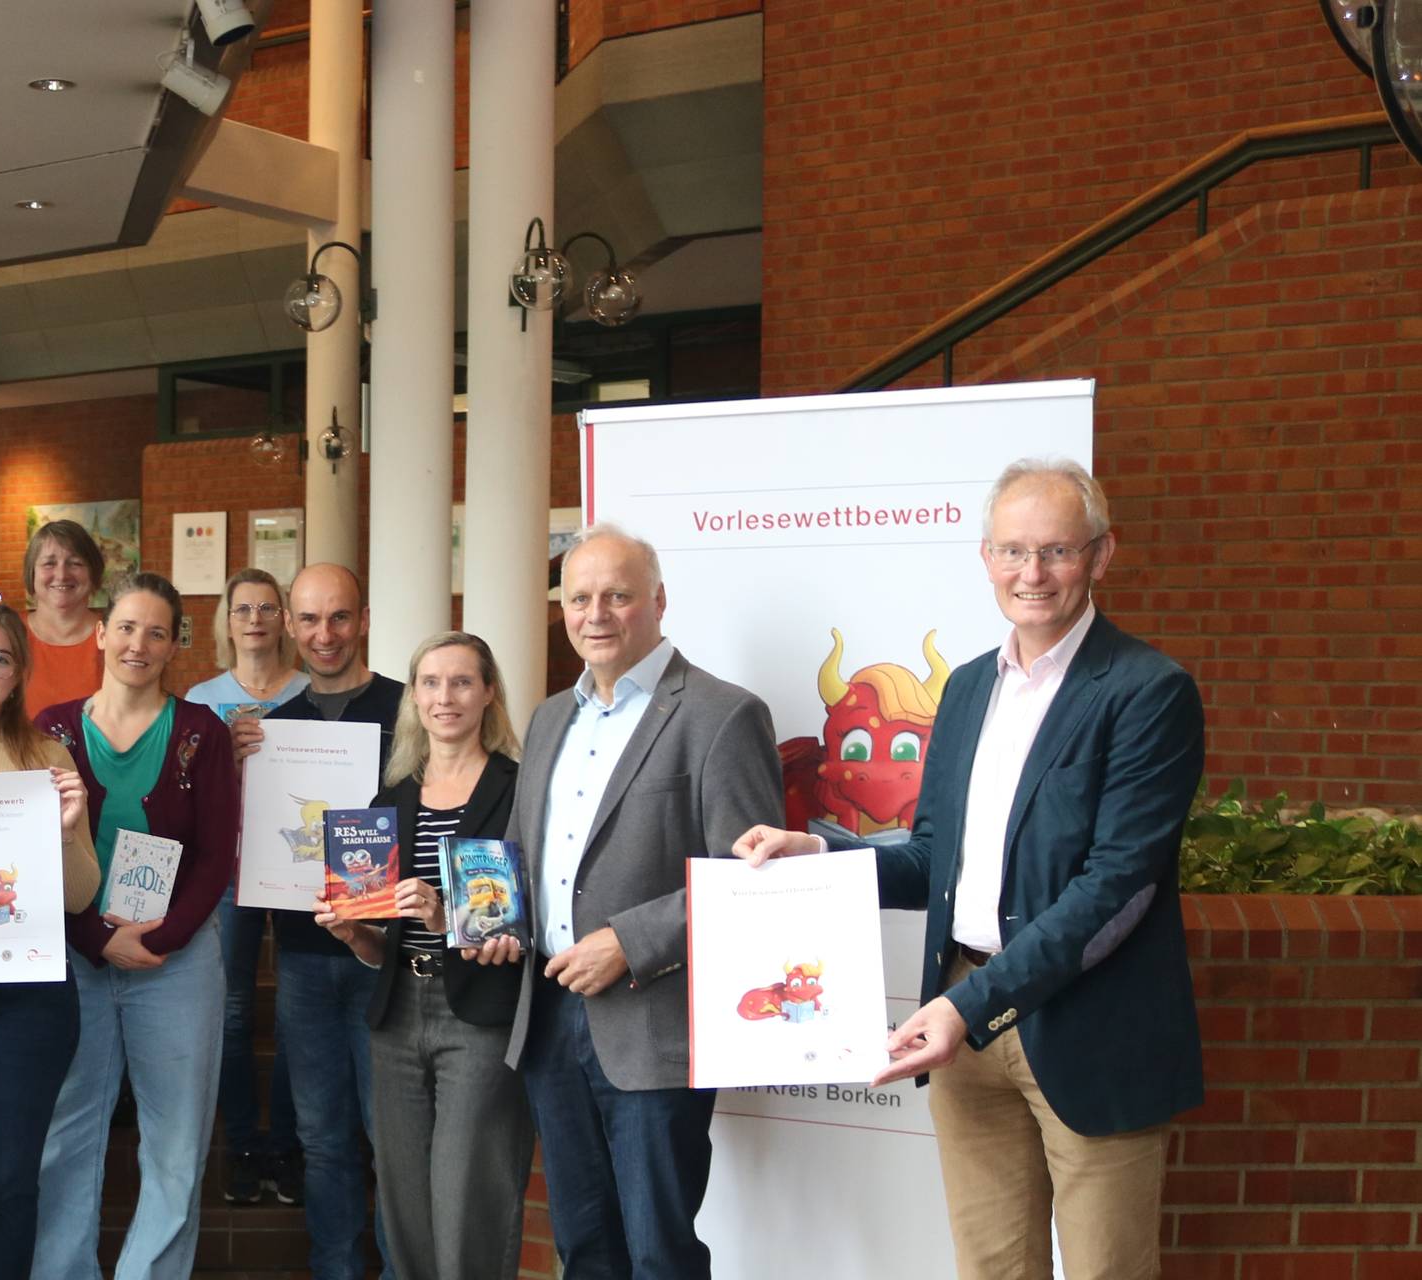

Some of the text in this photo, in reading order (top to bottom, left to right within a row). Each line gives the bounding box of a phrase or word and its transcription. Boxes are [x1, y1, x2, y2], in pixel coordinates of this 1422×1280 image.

[692, 501, 962, 533] Vorlesewettbewerb
[333, 826, 358, 837] RES
[342, 836, 392, 845] NACH HAUSE
[119, 865, 166, 896] BIRDIE
[826, 1084, 901, 1107] Borken
